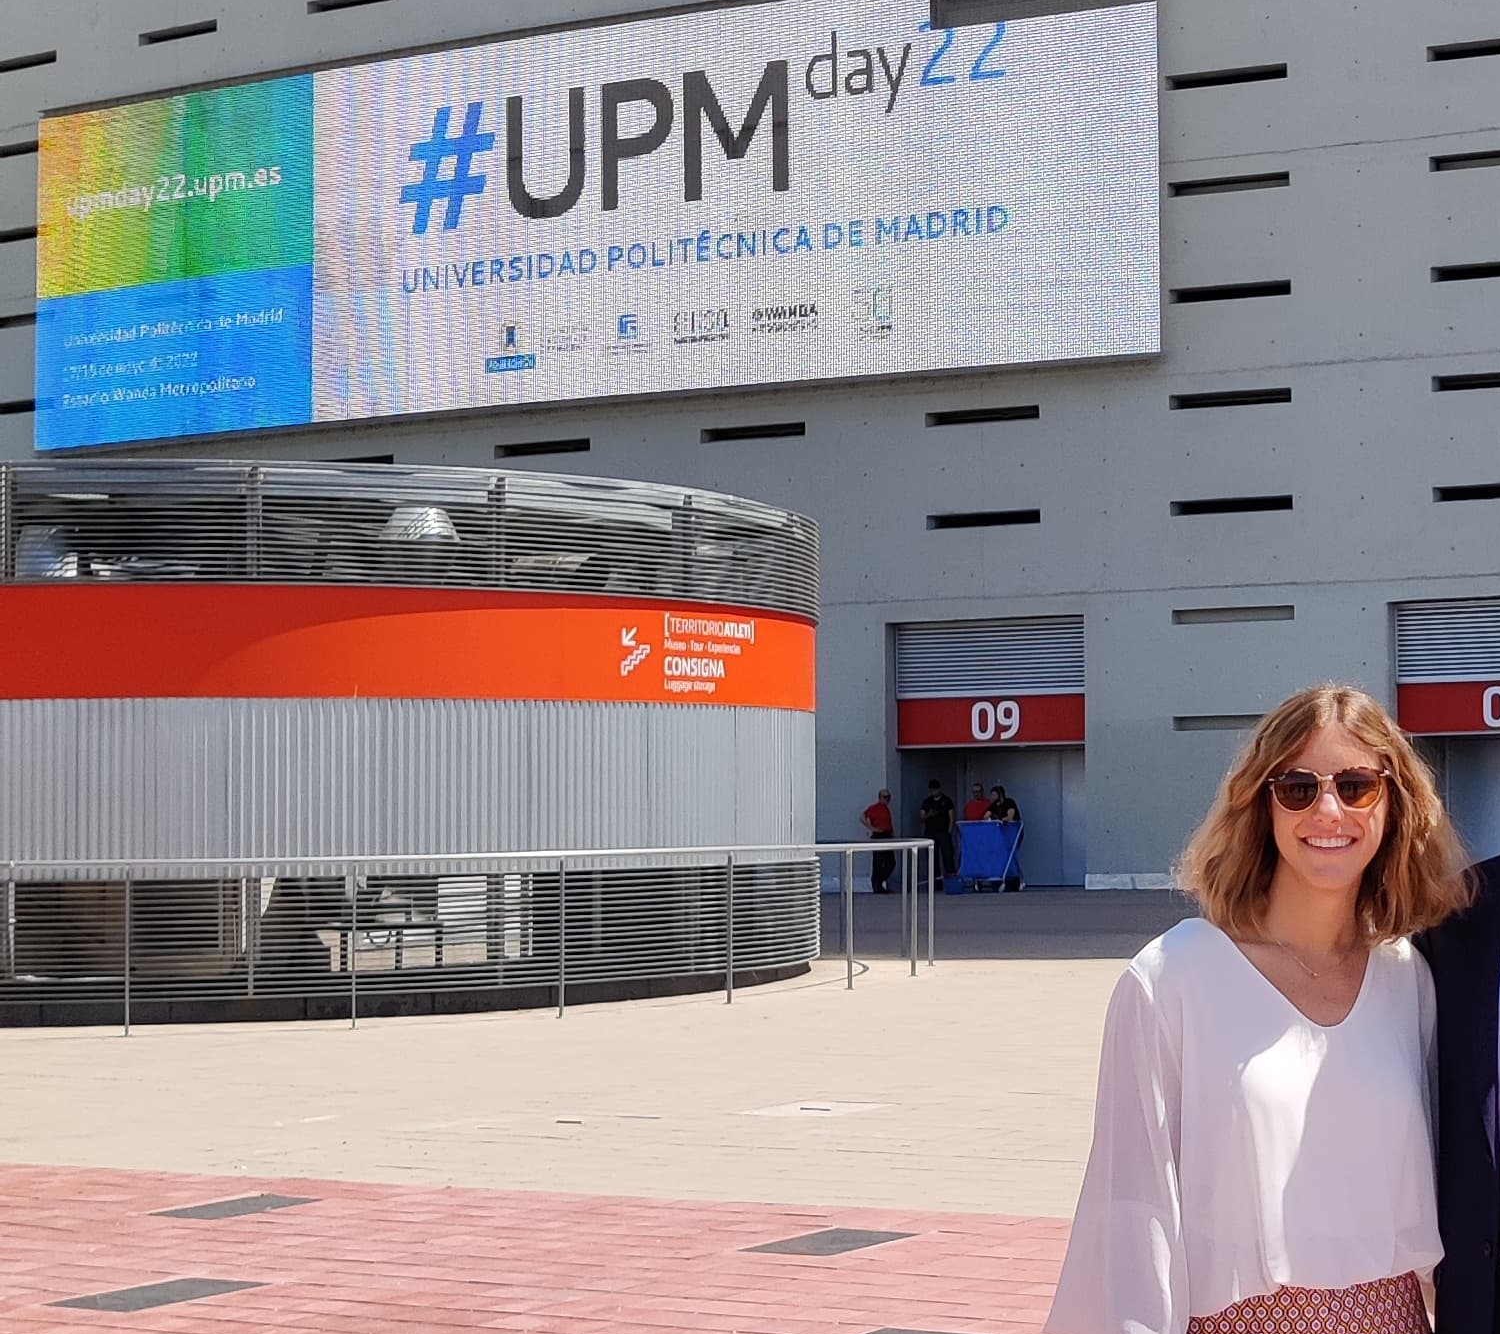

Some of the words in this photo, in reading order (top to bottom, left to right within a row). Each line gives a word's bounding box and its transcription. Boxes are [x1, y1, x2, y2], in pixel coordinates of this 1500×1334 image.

[401, 248, 597, 295] UNIVERSIDAD
[608, 227, 813, 273] POLITÉCNICA
[823, 222, 864, 249] DE
[876, 205, 1010, 246] MADRID
[664, 638, 687, 651] Museo
[690, 640, 705, 652] Tour
[707, 641, 741, 655] Experiencias
[664, 655, 726, 678] CONSIGNA
[664, 678, 692, 693] Luggage
[693, 680, 716, 694] storage
[971, 700, 1021, 741] 09
